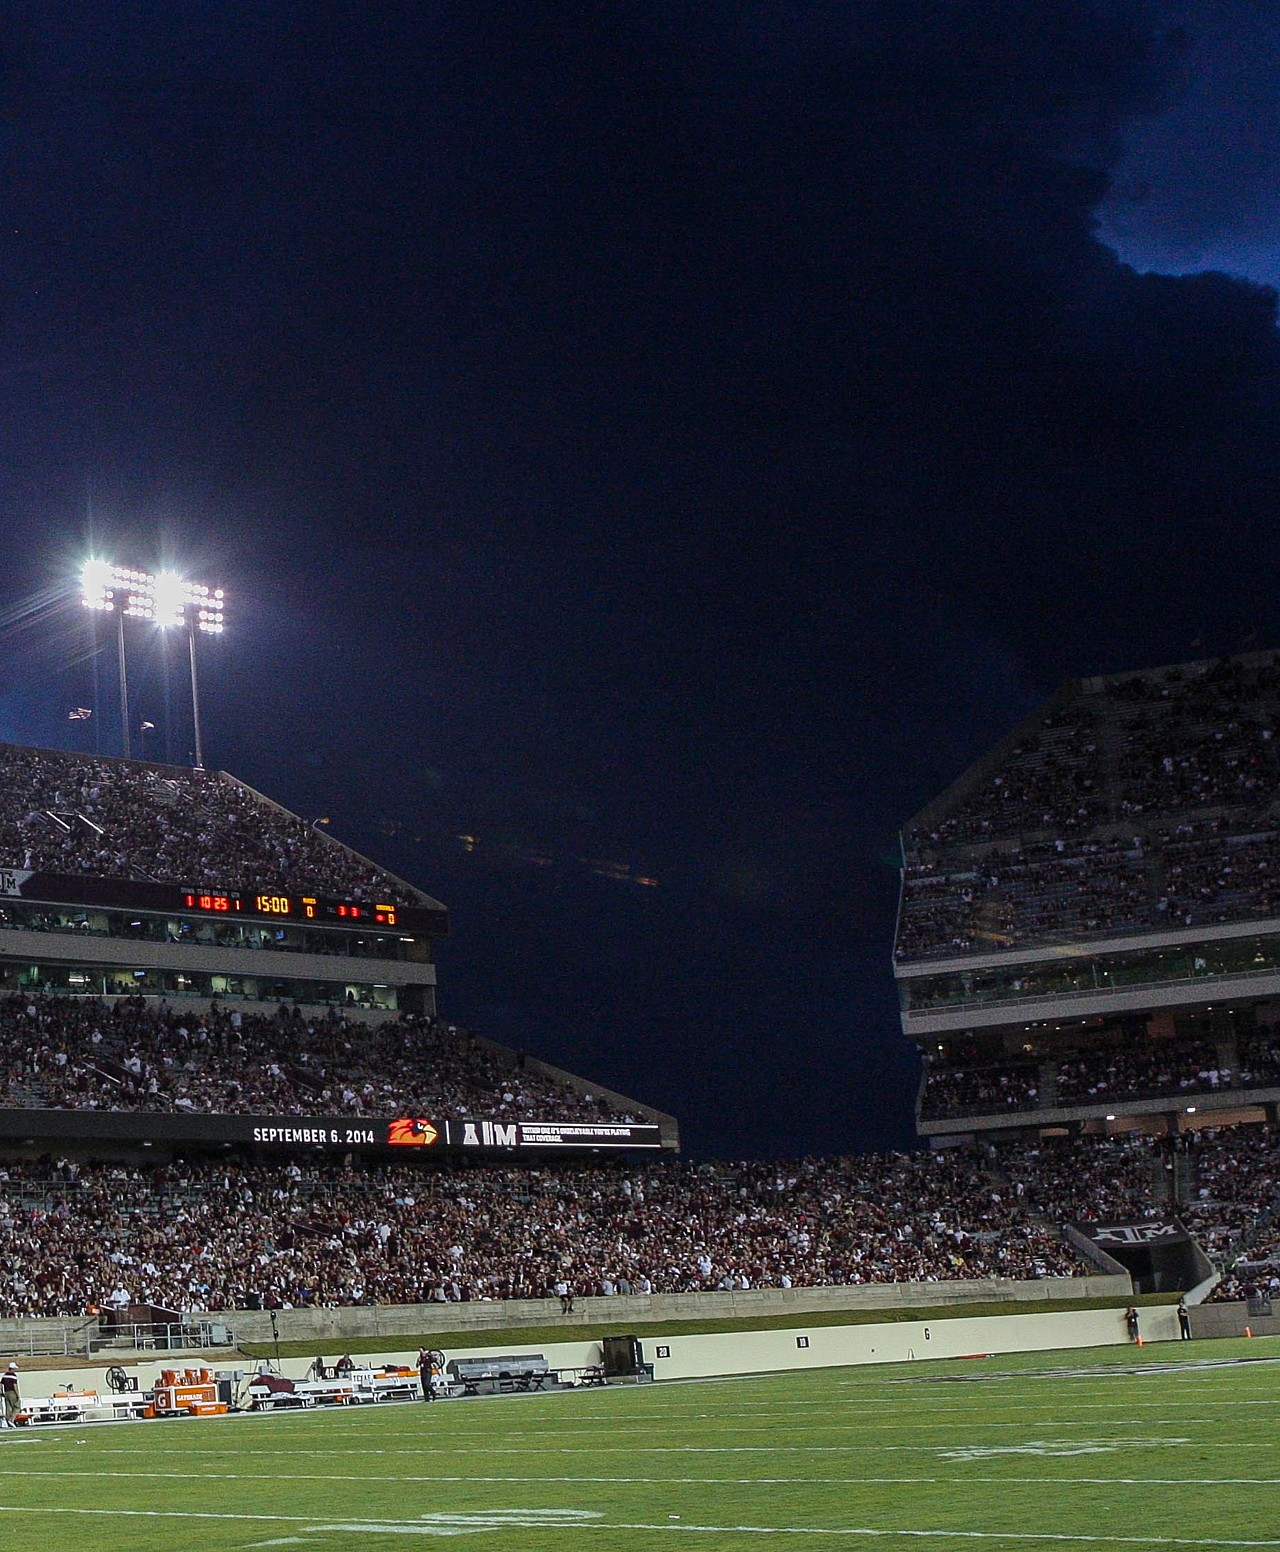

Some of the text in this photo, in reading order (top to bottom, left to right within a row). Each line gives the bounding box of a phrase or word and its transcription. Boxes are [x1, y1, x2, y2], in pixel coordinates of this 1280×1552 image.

[201, 896, 211, 909] 10
[214, 897, 227, 910] 25
[257, 896, 289, 913] 15:00
[306, 905, 314, 917] 0
[387, 913, 395, 925] 0
[253, 1127, 327, 1143] SEPTEMBER
[346, 1129, 375, 1143] 2014
[924, 1328, 930, 1340] G
[324, 1367, 335, 1379] 40
[158, 1393, 166, 1407] G
